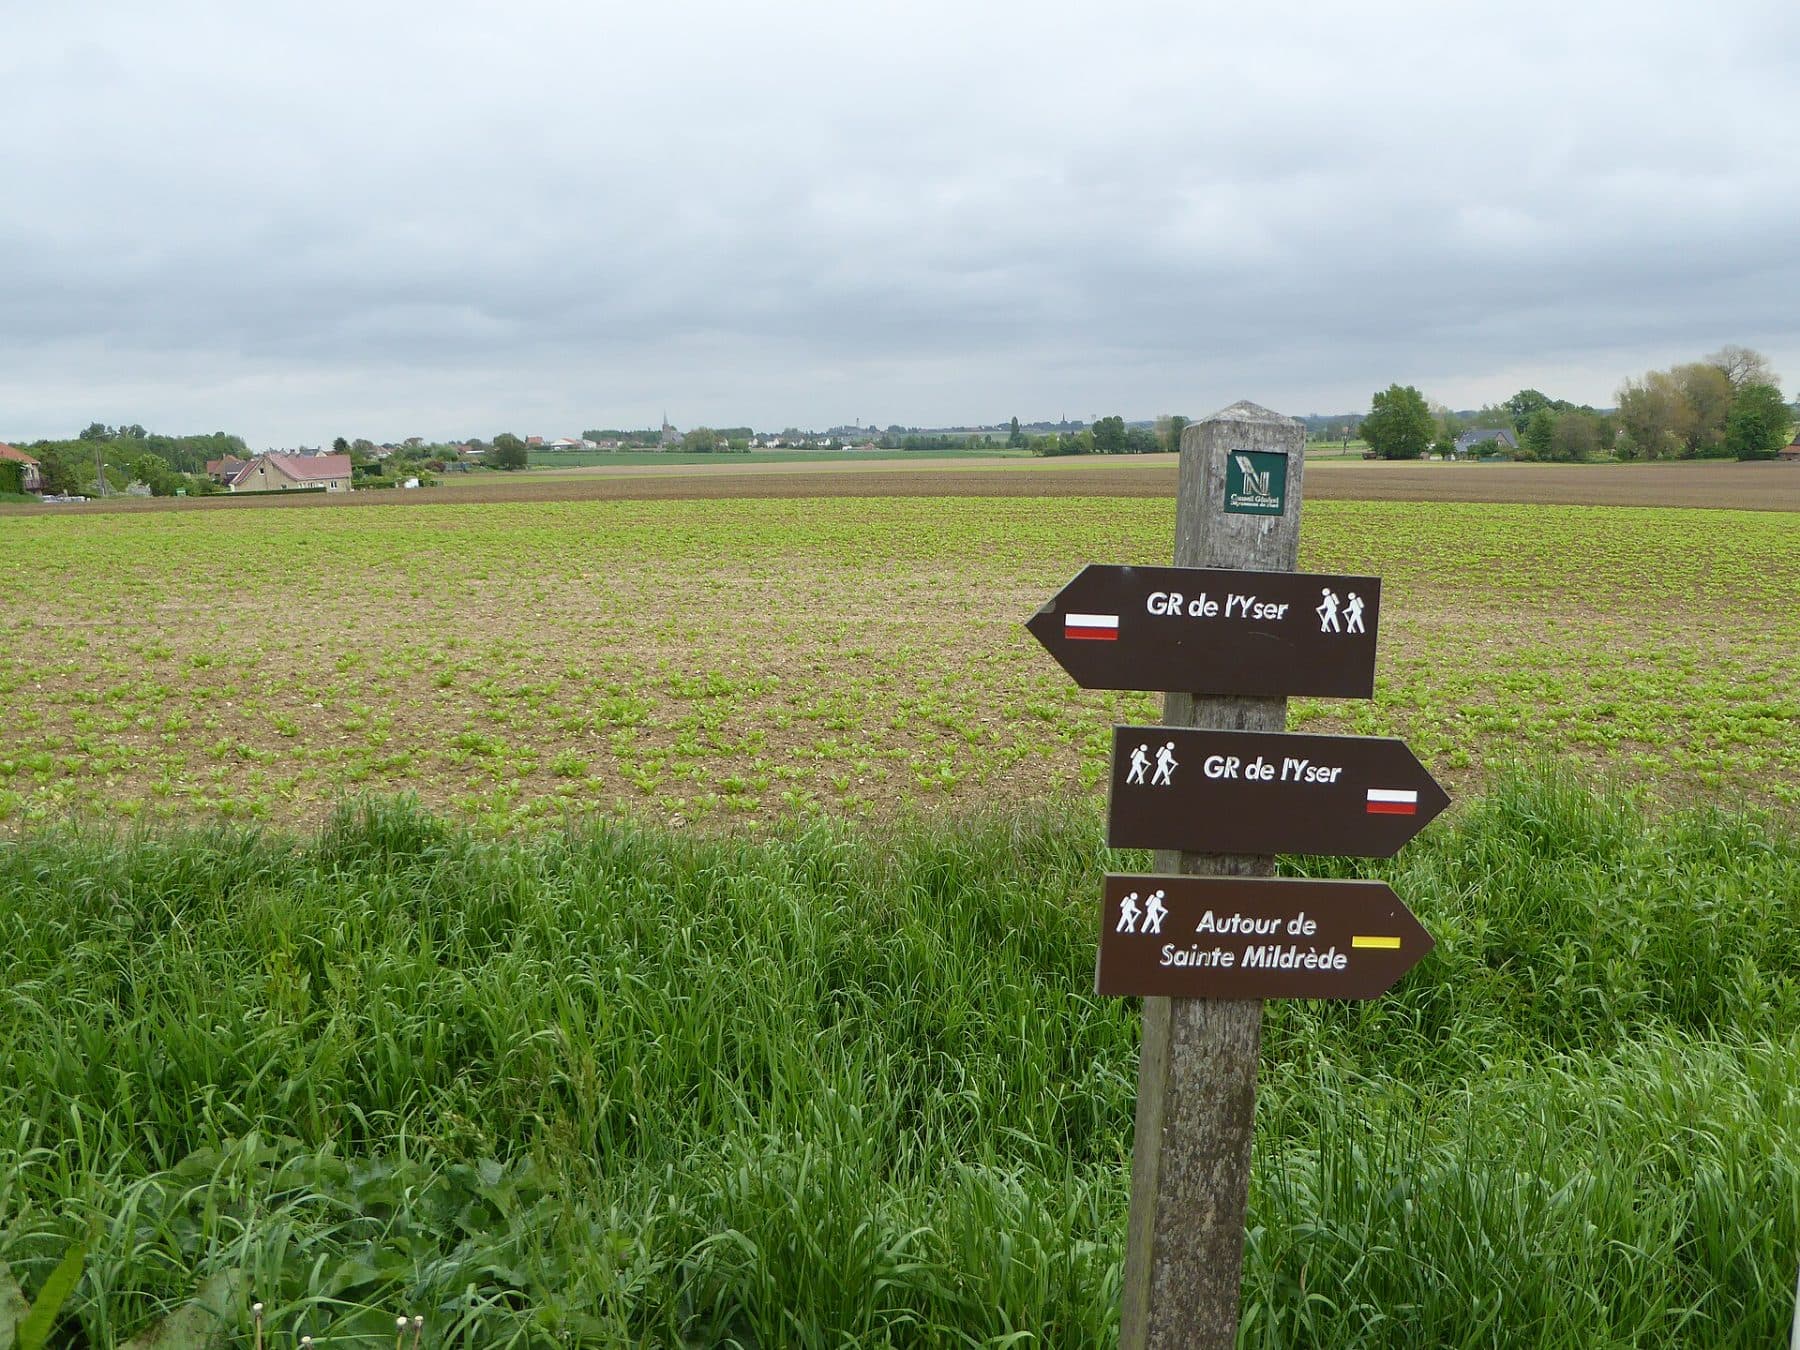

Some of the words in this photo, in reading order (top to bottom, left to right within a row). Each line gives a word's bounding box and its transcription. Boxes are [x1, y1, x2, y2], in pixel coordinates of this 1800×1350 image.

[1146, 591, 1183, 616] GR
[1188, 592, 1218, 618] de
[1224, 593, 1289, 620] l'Yser
[1203, 756, 1240, 779] GR
[1244, 756, 1275, 780] de
[1280, 757, 1343, 783] l'Yser
[1196, 910, 1282, 935] Autour
[1286, 911, 1317, 936] de
[1159, 942, 1235, 968] Sainte
[1240, 944, 1348, 970] Mildrède
